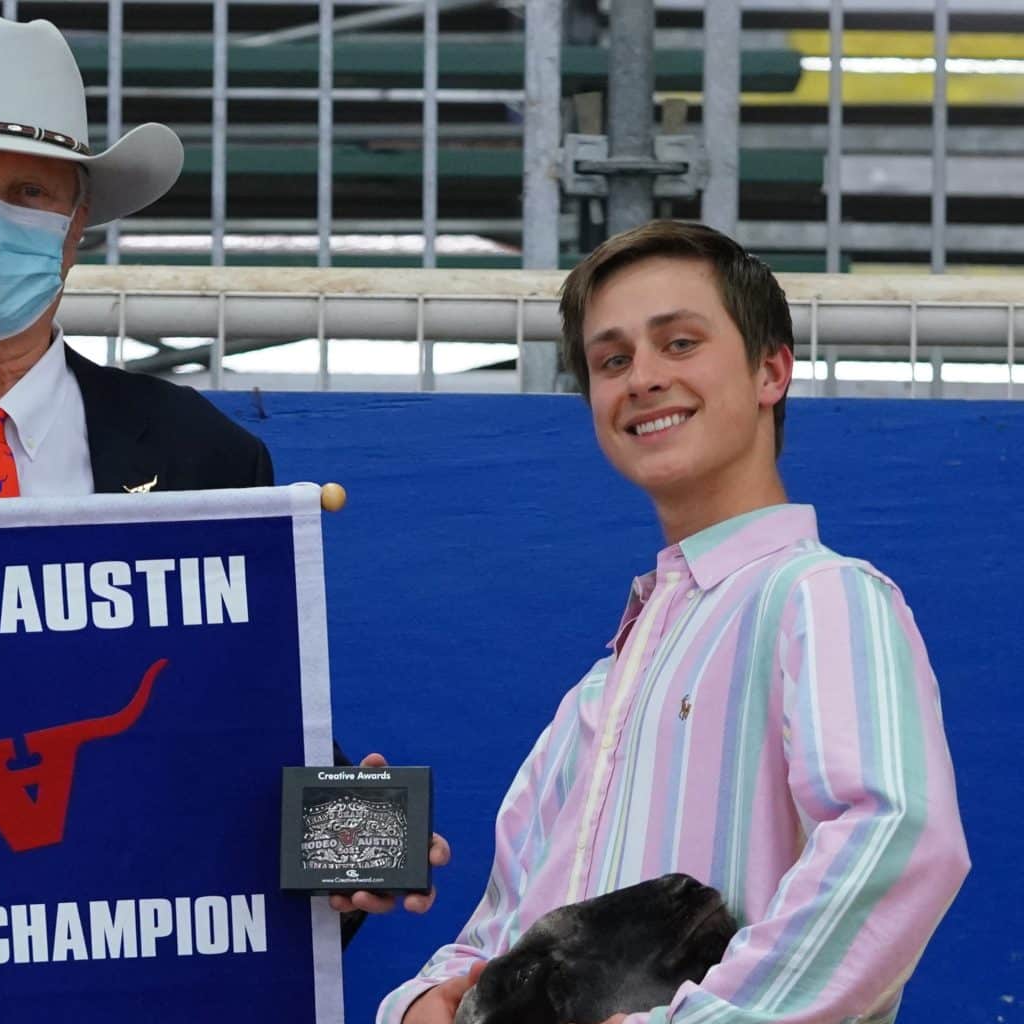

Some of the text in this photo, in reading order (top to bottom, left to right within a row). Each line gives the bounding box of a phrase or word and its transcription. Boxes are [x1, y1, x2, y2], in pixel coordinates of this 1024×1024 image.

[0, 555, 249, 634] AUSTIN
[318, 771, 391, 780] Creative Awards
[301, 837, 399, 850] RODEO AUSTIN
